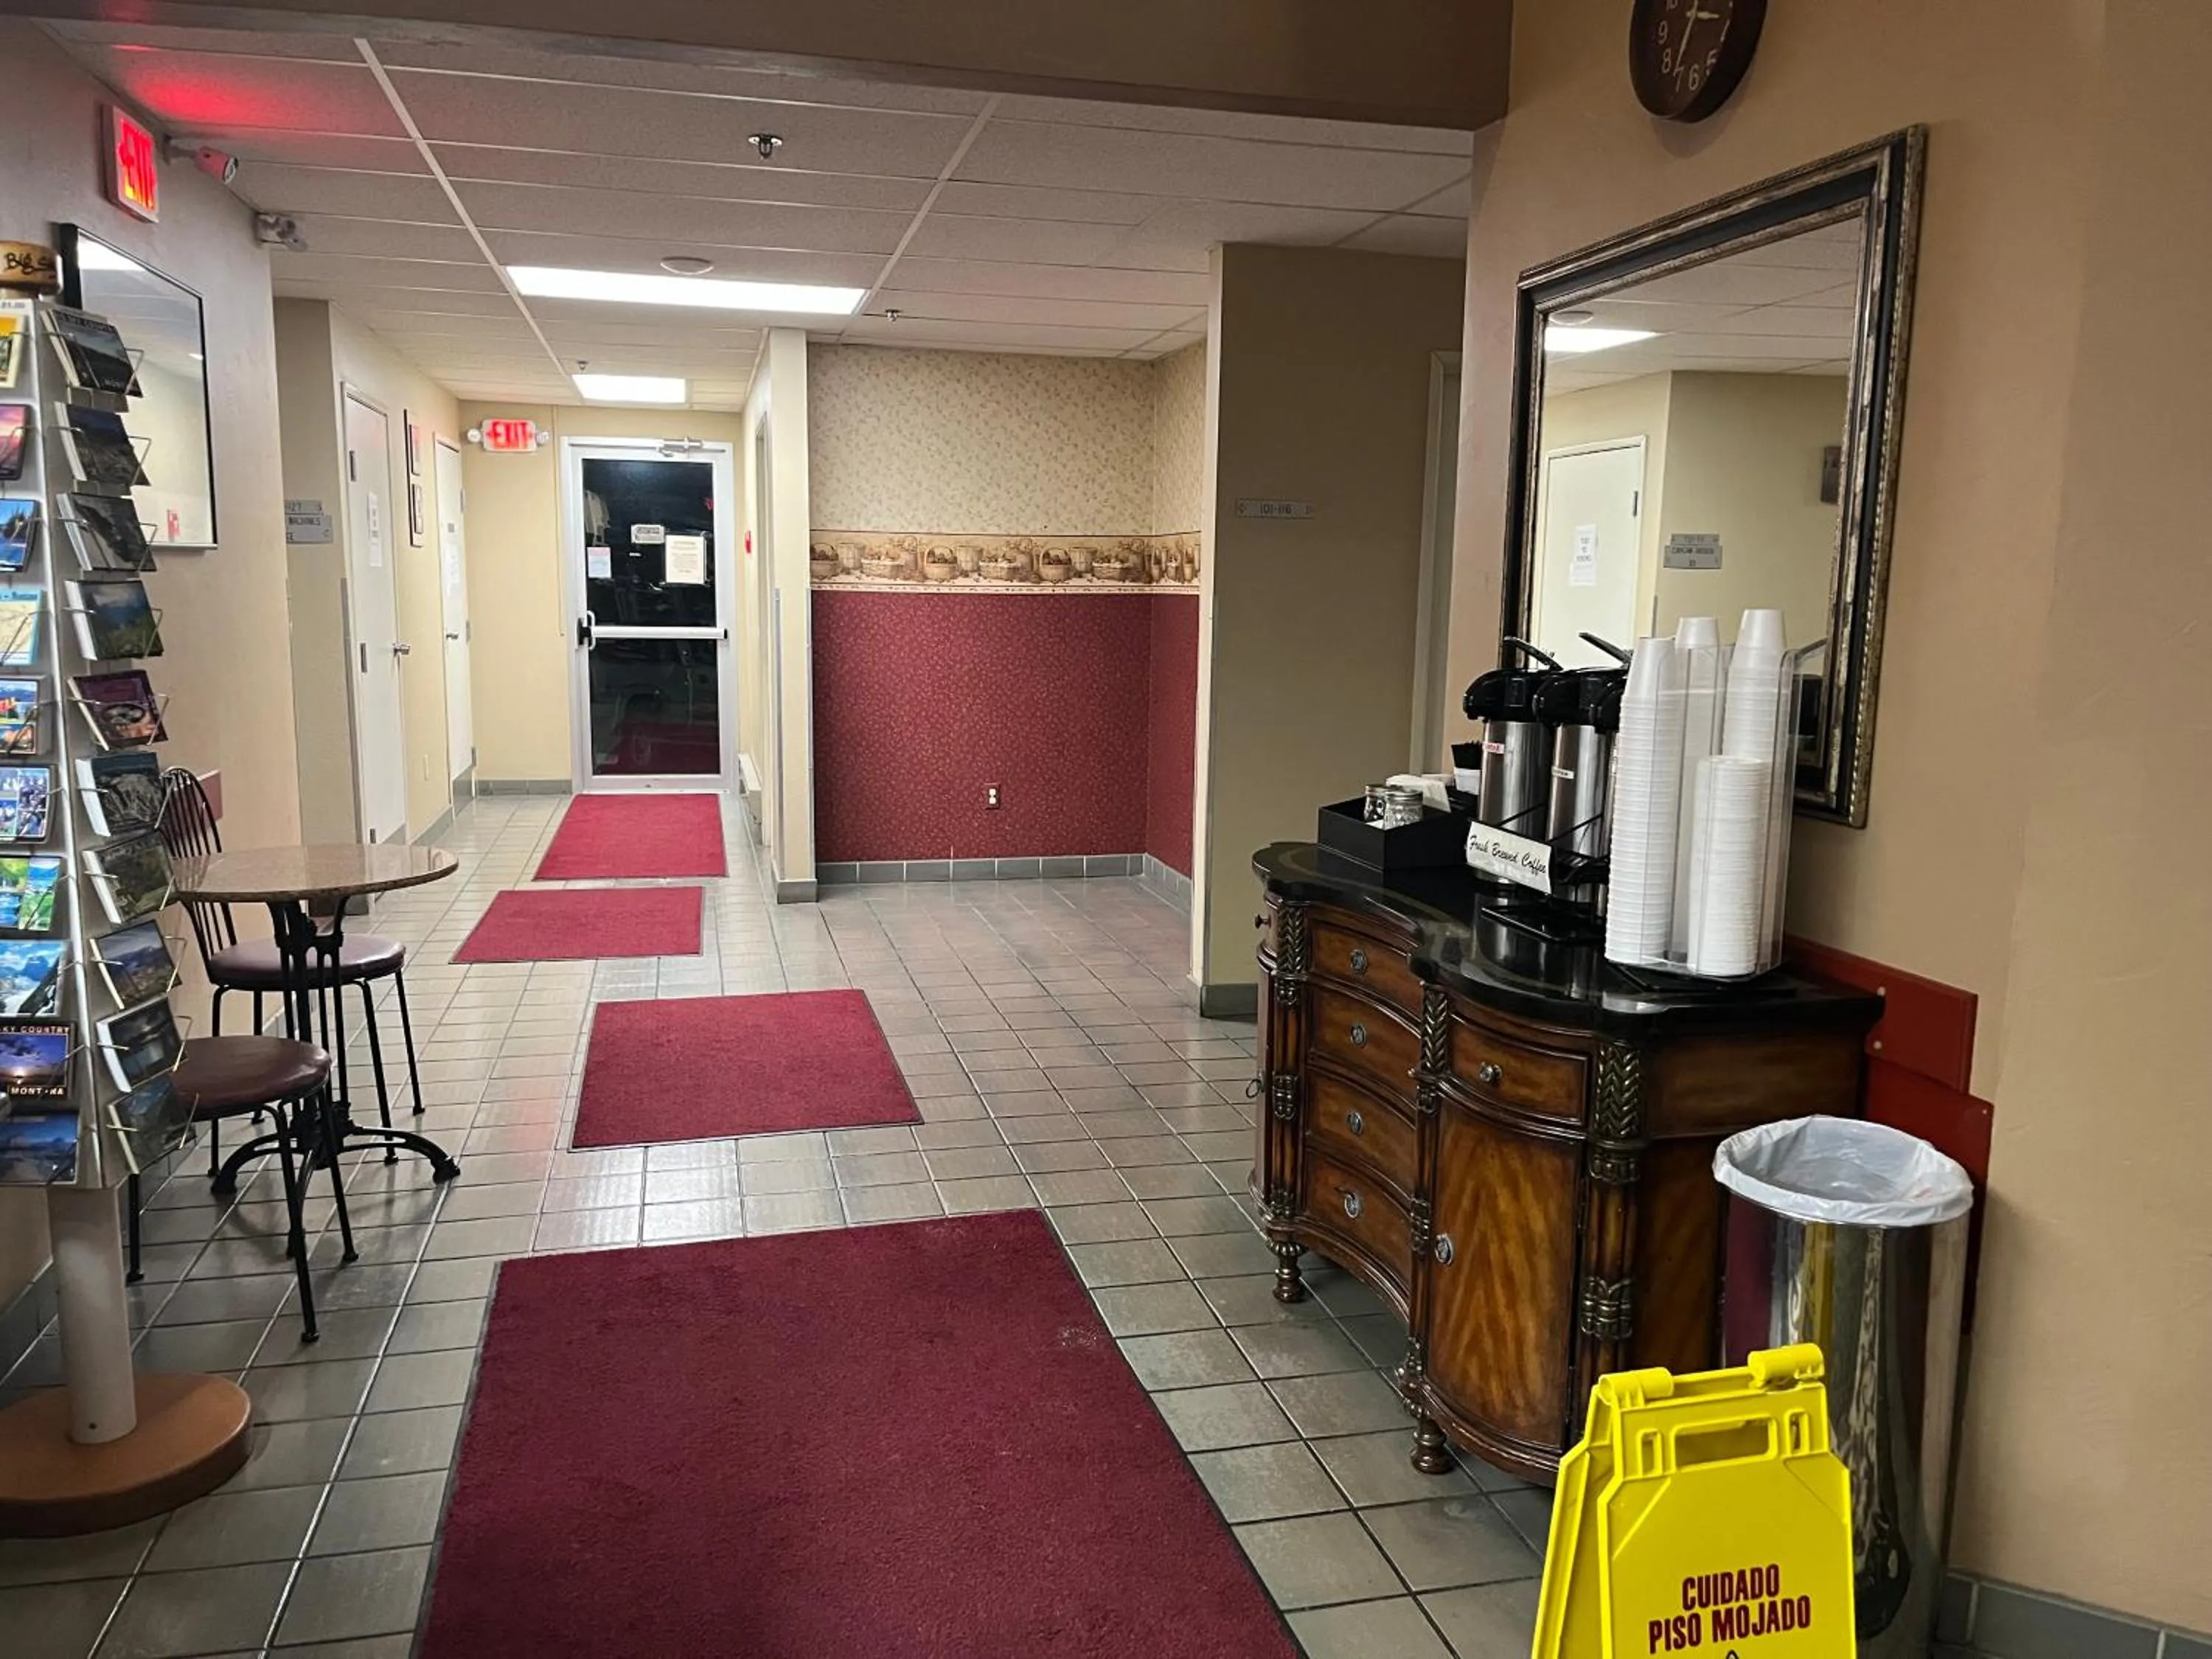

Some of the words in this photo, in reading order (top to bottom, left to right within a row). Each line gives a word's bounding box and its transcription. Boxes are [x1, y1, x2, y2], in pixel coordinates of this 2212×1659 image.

[1658, 20, 1669, 44] 9
[1662, 48, 1672, 74] 8
[1673, 66, 1685, 92] 7
[1688, 63, 1700, 91] 6
[492, 421, 528, 448] EXIT
[1521, 852, 1547, 876] Coffee
[1682, 1563, 1780, 1611] CUIDADO
[1648, 1613, 1702, 1655] PISO
[1711, 1595, 1812, 1644] MOJADO
